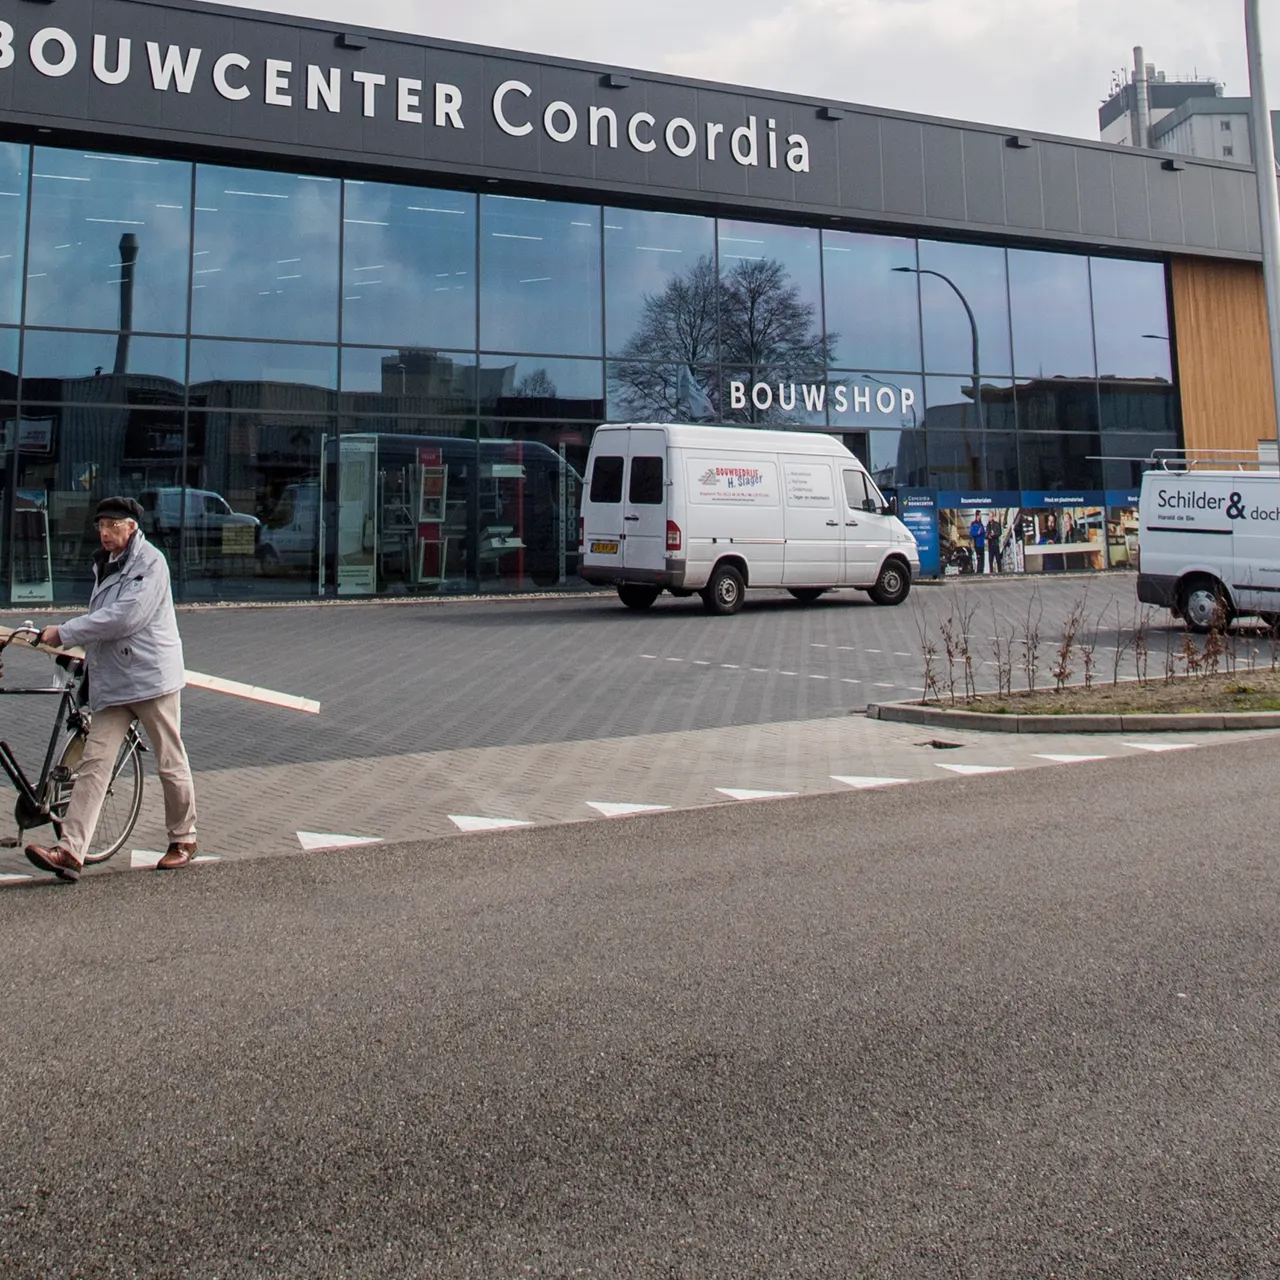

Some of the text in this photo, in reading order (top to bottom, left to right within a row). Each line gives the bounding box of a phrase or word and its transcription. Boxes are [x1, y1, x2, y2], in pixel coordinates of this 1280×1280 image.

[492, 79, 811, 173] Concordia
[730, 381, 915, 414] BOUWSHOP
[1157, 489, 1226, 510] Schilder
[1225, 491, 1247, 520] &
